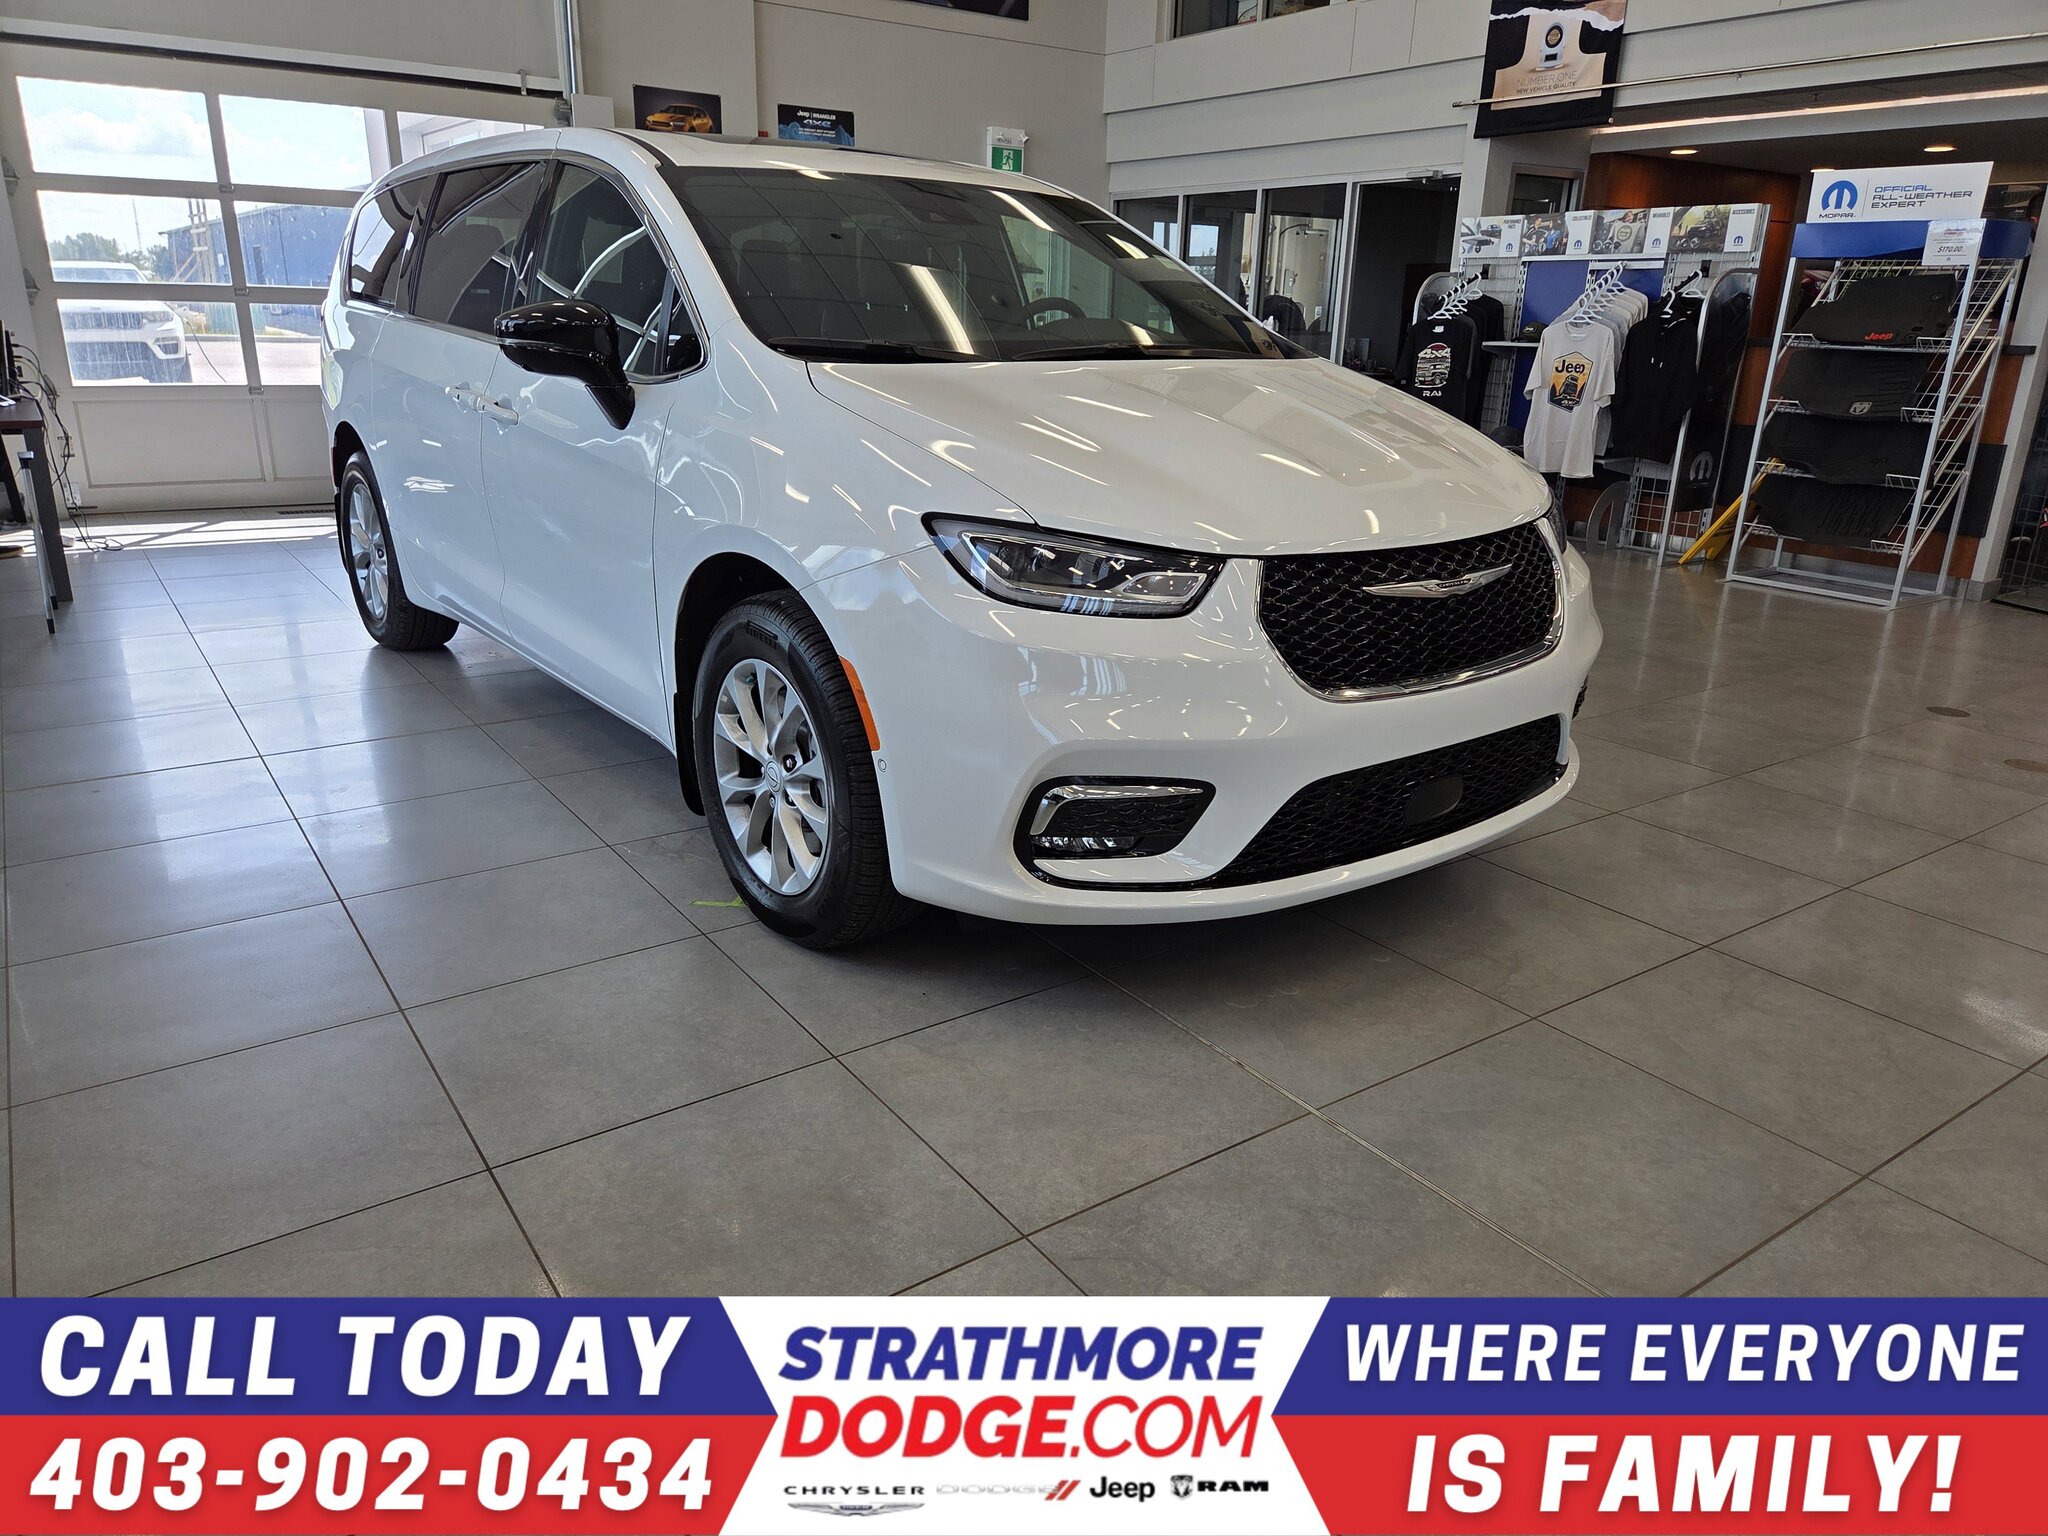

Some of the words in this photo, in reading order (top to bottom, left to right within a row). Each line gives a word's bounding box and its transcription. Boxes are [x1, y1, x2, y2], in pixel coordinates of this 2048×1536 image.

[1516, 74, 1556, 87] NUMBER
[1557, 71, 1578, 81] ONE
[1553, 81, 1577, 90] QUALITY
[797, 110, 810, 118] Jeep
[1874, 184, 1933, 193] OFFICIAL
[1873, 190, 1973, 201] ALL-WEATHER
[1871, 200, 1926, 209] EXPERT
[1864, 332, 1893, 341] Jeep
[1418, 347, 1451, 358] 4x4
[1439, 580, 1468, 588] CHRYSLER
